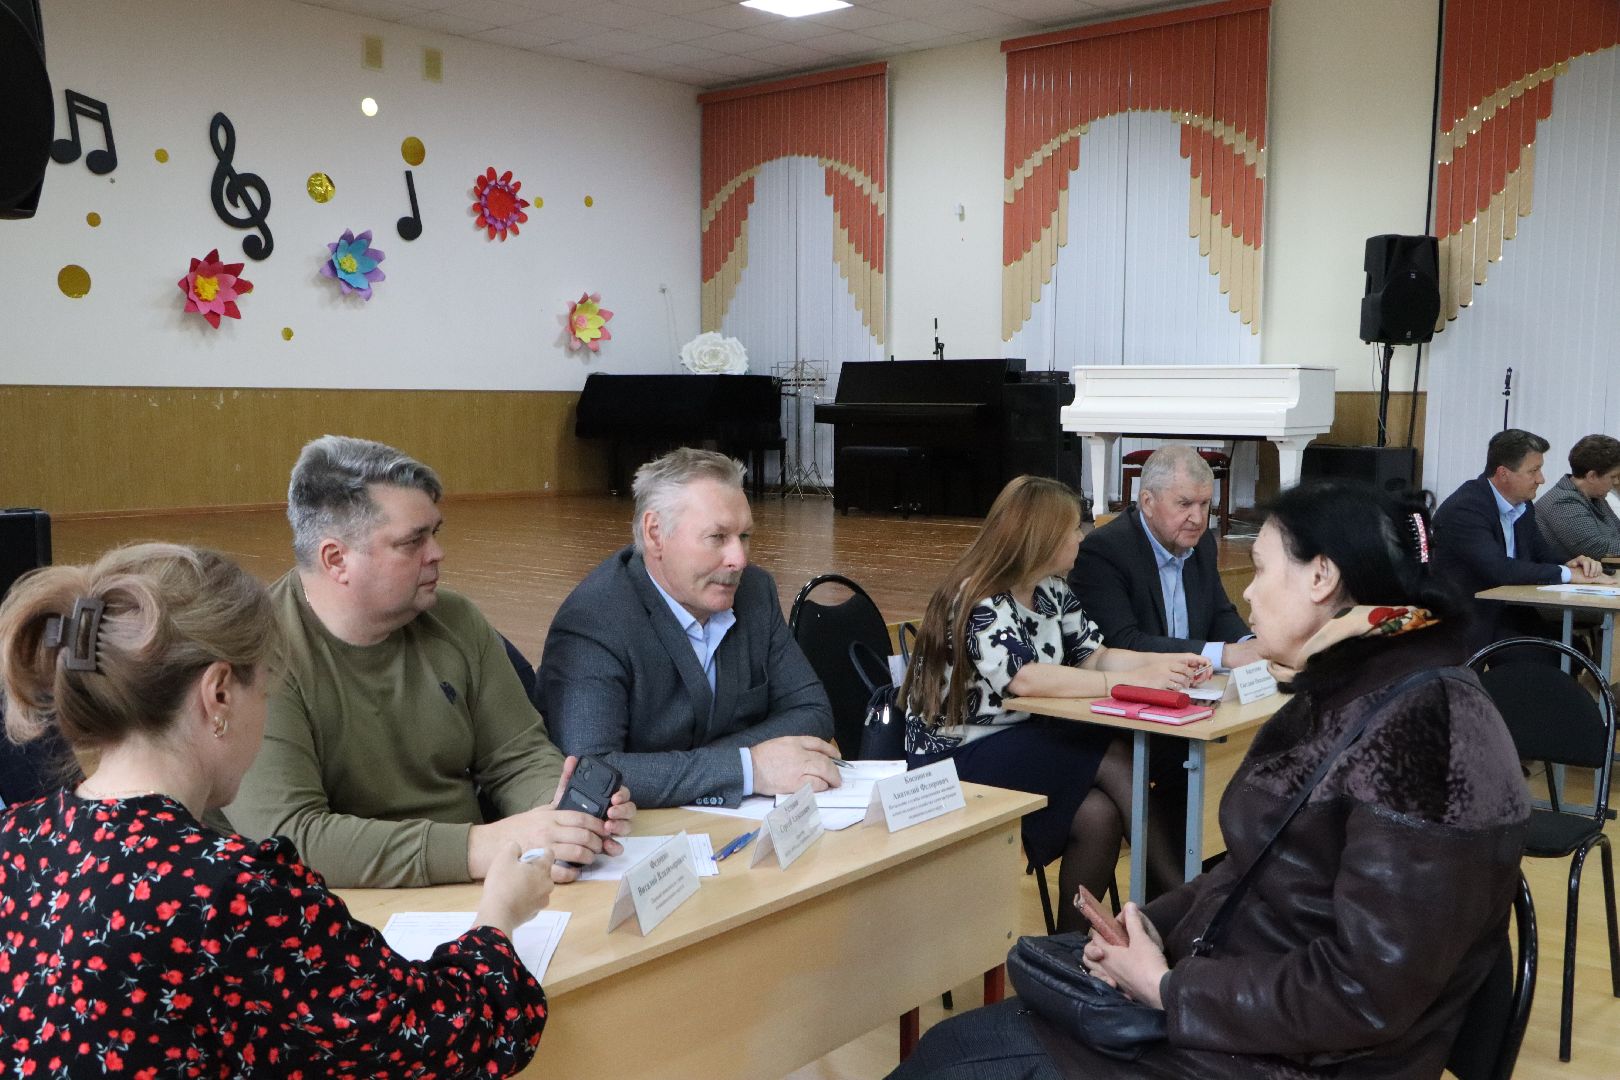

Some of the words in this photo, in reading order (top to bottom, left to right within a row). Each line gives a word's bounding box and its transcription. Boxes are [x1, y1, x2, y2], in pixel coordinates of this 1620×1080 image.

[892, 786, 919, 800] Анатолий
[920, 776, 949, 792] Федорович
[637, 875, 657, 897] Виталий
